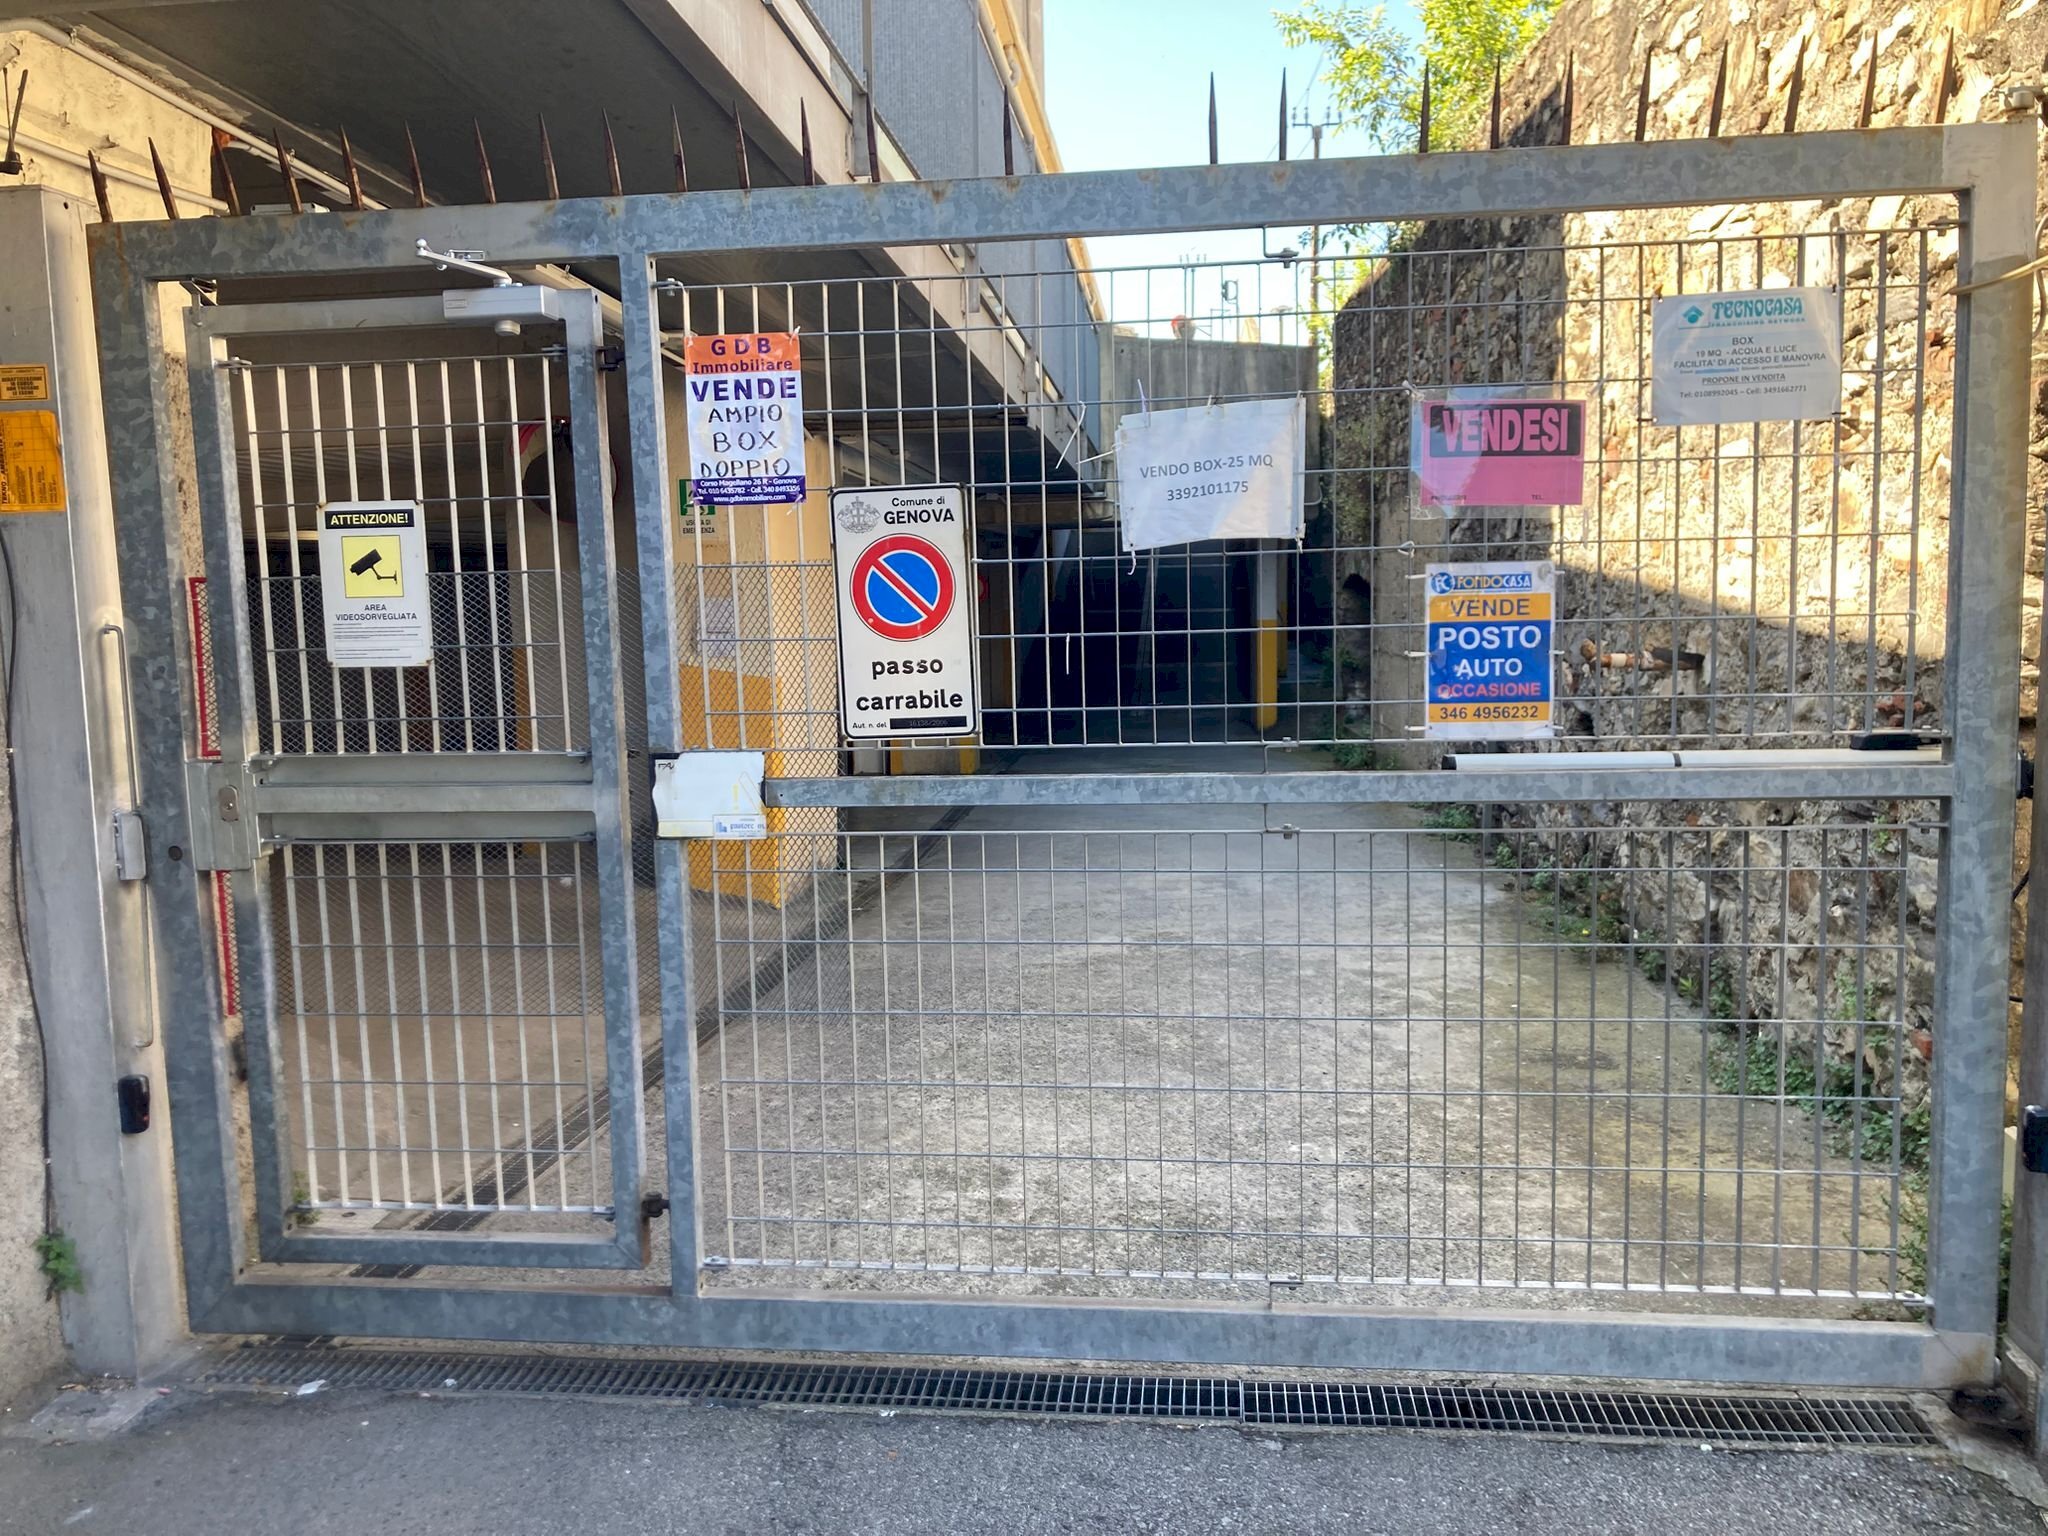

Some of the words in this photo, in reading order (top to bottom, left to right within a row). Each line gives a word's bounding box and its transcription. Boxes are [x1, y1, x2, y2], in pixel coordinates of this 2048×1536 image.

[1712, 297, 1802, 320] TECNOCASA
[1731, 336, 1754, 346] BOX
[1707, 349, 1722, 357] MQ
[1731, 346, 1763, 356] ACQUA
[1766, 346, 1772, 354] E
[1774, 344, 1797, 353] LUCE
[693, 359, 793, 374] Immobiliare
[1674, 359, 1716, 369] FACILITA'
[1718, 359, 1727, 367] DI
[1729, 355, 1772, 366] ACCESSO
[1774, 355, 1780, 363] E
[1782, 352, 1826, 362] MANOVRA
[1702, 374, 1739, 384] PROPONE
[1741, 374, 1750, 383] IN
[1752, 372, 1786, 382] VENDITA
[690, 377, 798, 402] VENDE
[708, 404, 783, 424] AMPIO
[1442, 407, 1569, 453] VENDESI
[713, 430, 778, 453] BOX
[700, 457, 790, 478] DOPPIO
[1140, 462, 1190, 478] VENDO
[1194, 455, 1244, 473] BOX-25
[1249, 454, 1273, 467] MQ
[719, 479, 752, 488] Magellano
[773, 477, 797, 485] Genova
[1167, 480, 1249, 501] 3392101175
[891, 497, 933, 507] Comune
[936, 496, 945, 505] di
[330, 513, 409, 526] ATTENZIONE!
[883, 508, 955, 525] GENOVA
[364, 604, 387, 612] AREA
[1450, 599, 1531, 617] VENDE
[335, 613, 417, 621] VIDEOSORVEGLIATA
[1439, 625, 1542, 650] POSTO
[871, 658, 944, 680] passo
[1456, 658, 1523, 677] AUTO
[1437, 682, 1541, 698] OCCASIONE
[856, 689, 963, 711] carrabile
[1440, 707, 1467, 720] 346
[1473, 705, 1539, 719] 4956232
